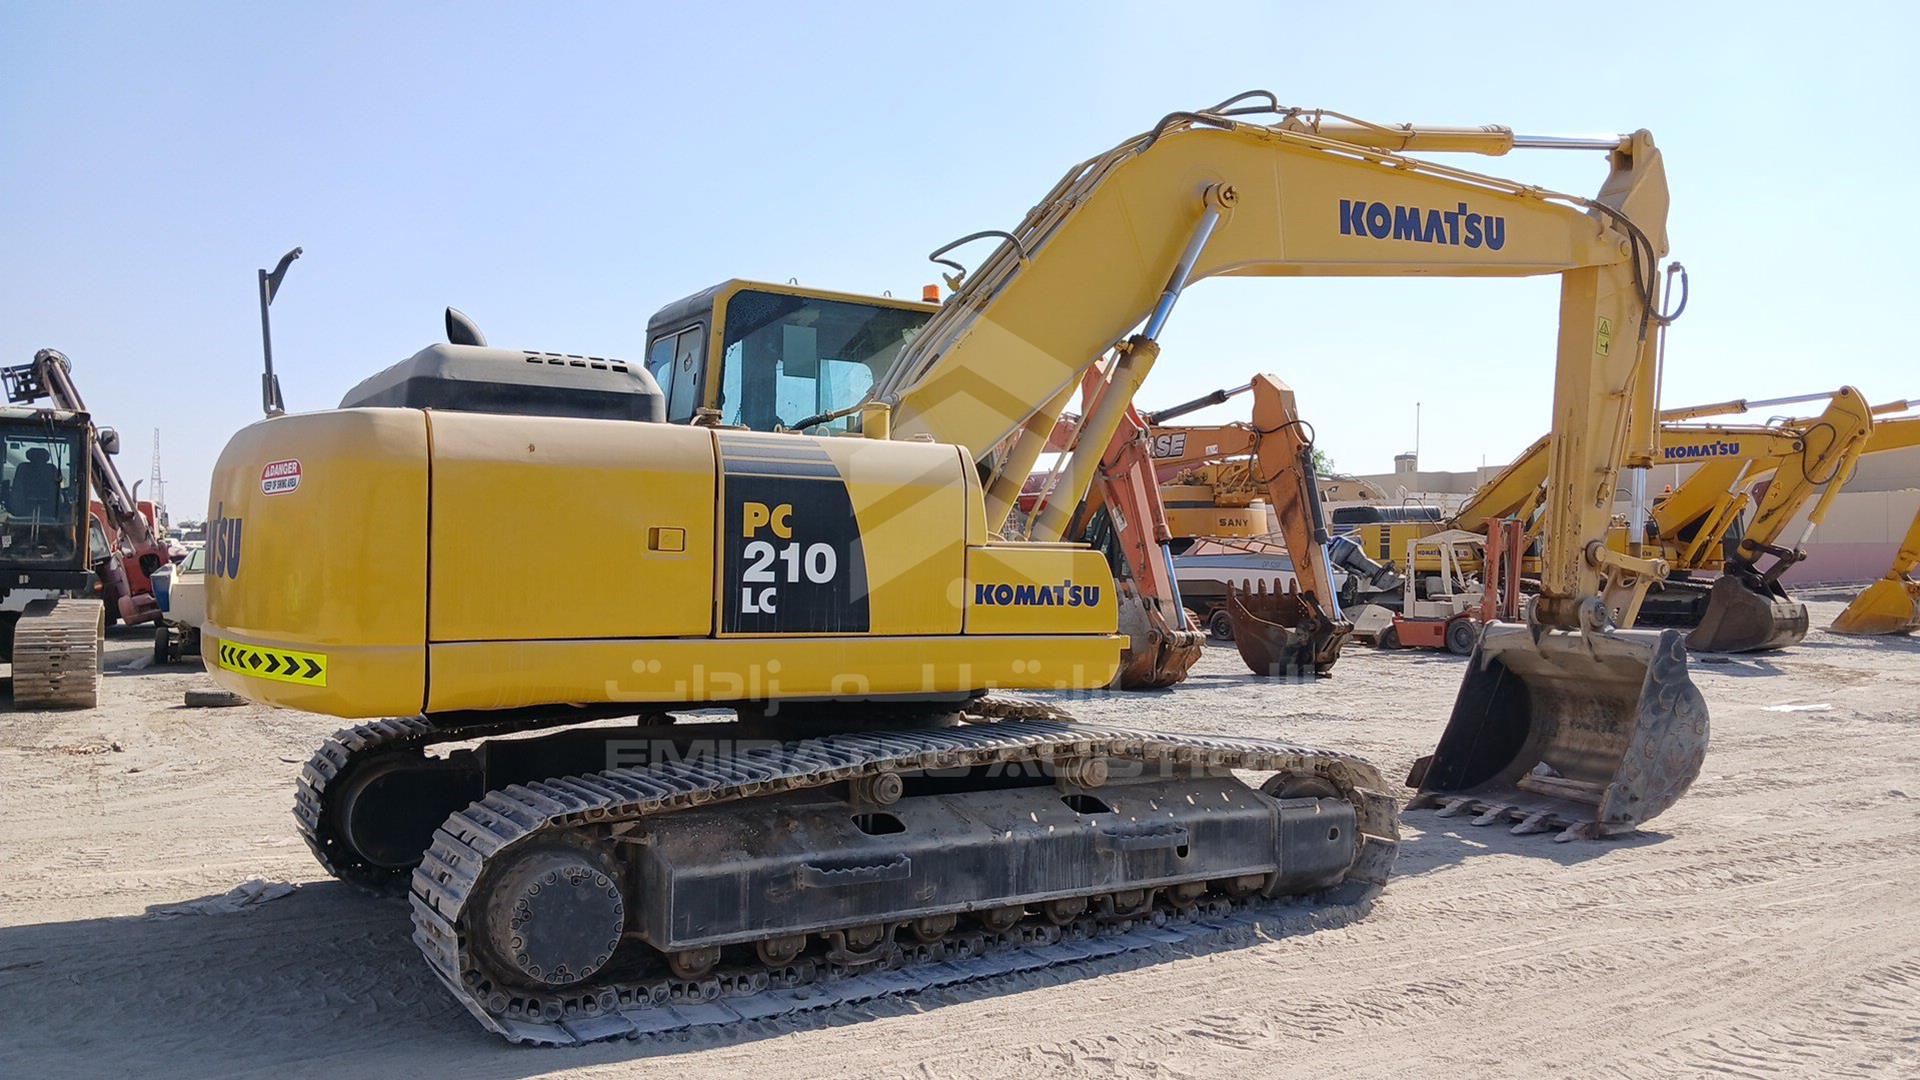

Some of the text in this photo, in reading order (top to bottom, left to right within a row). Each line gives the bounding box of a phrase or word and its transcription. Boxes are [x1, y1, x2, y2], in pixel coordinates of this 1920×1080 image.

[1339, 199, 1505, 250] KOMATSU
[1664, 440, 1740, 459] KOMATSU
[270, 462, 298, 477] DANGER
[743, 502, 793, 538] PC
[1219, 518, 1249, 527] SANY
[743, 541, 837, 584] 210
[742, 587, 777, 614] LC
[975, 580, 1100, 607] KOMATSU
